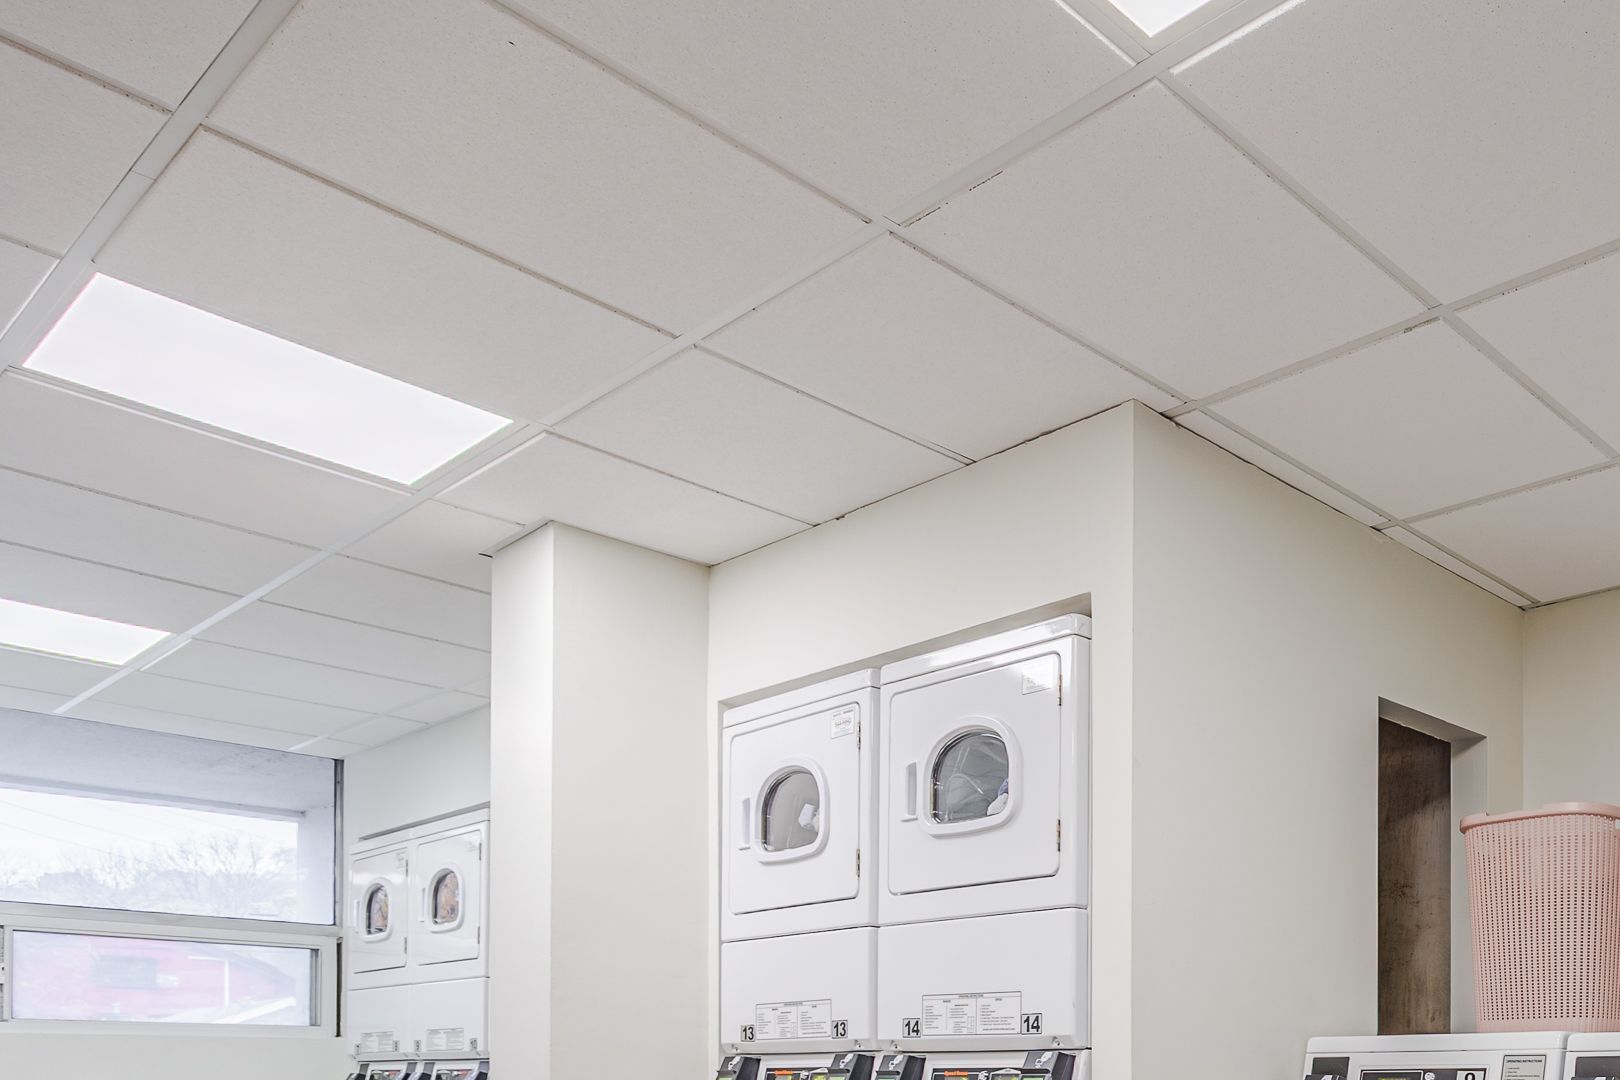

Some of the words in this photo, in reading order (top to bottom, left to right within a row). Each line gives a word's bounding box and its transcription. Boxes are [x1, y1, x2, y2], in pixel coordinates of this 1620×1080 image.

[834, 1021, 847, 1037] 13
[904, 1020, 920, 1036] 14
[1023, 1016, 1041, 1032] 14
[742, 1025, 754, 1041] 13
